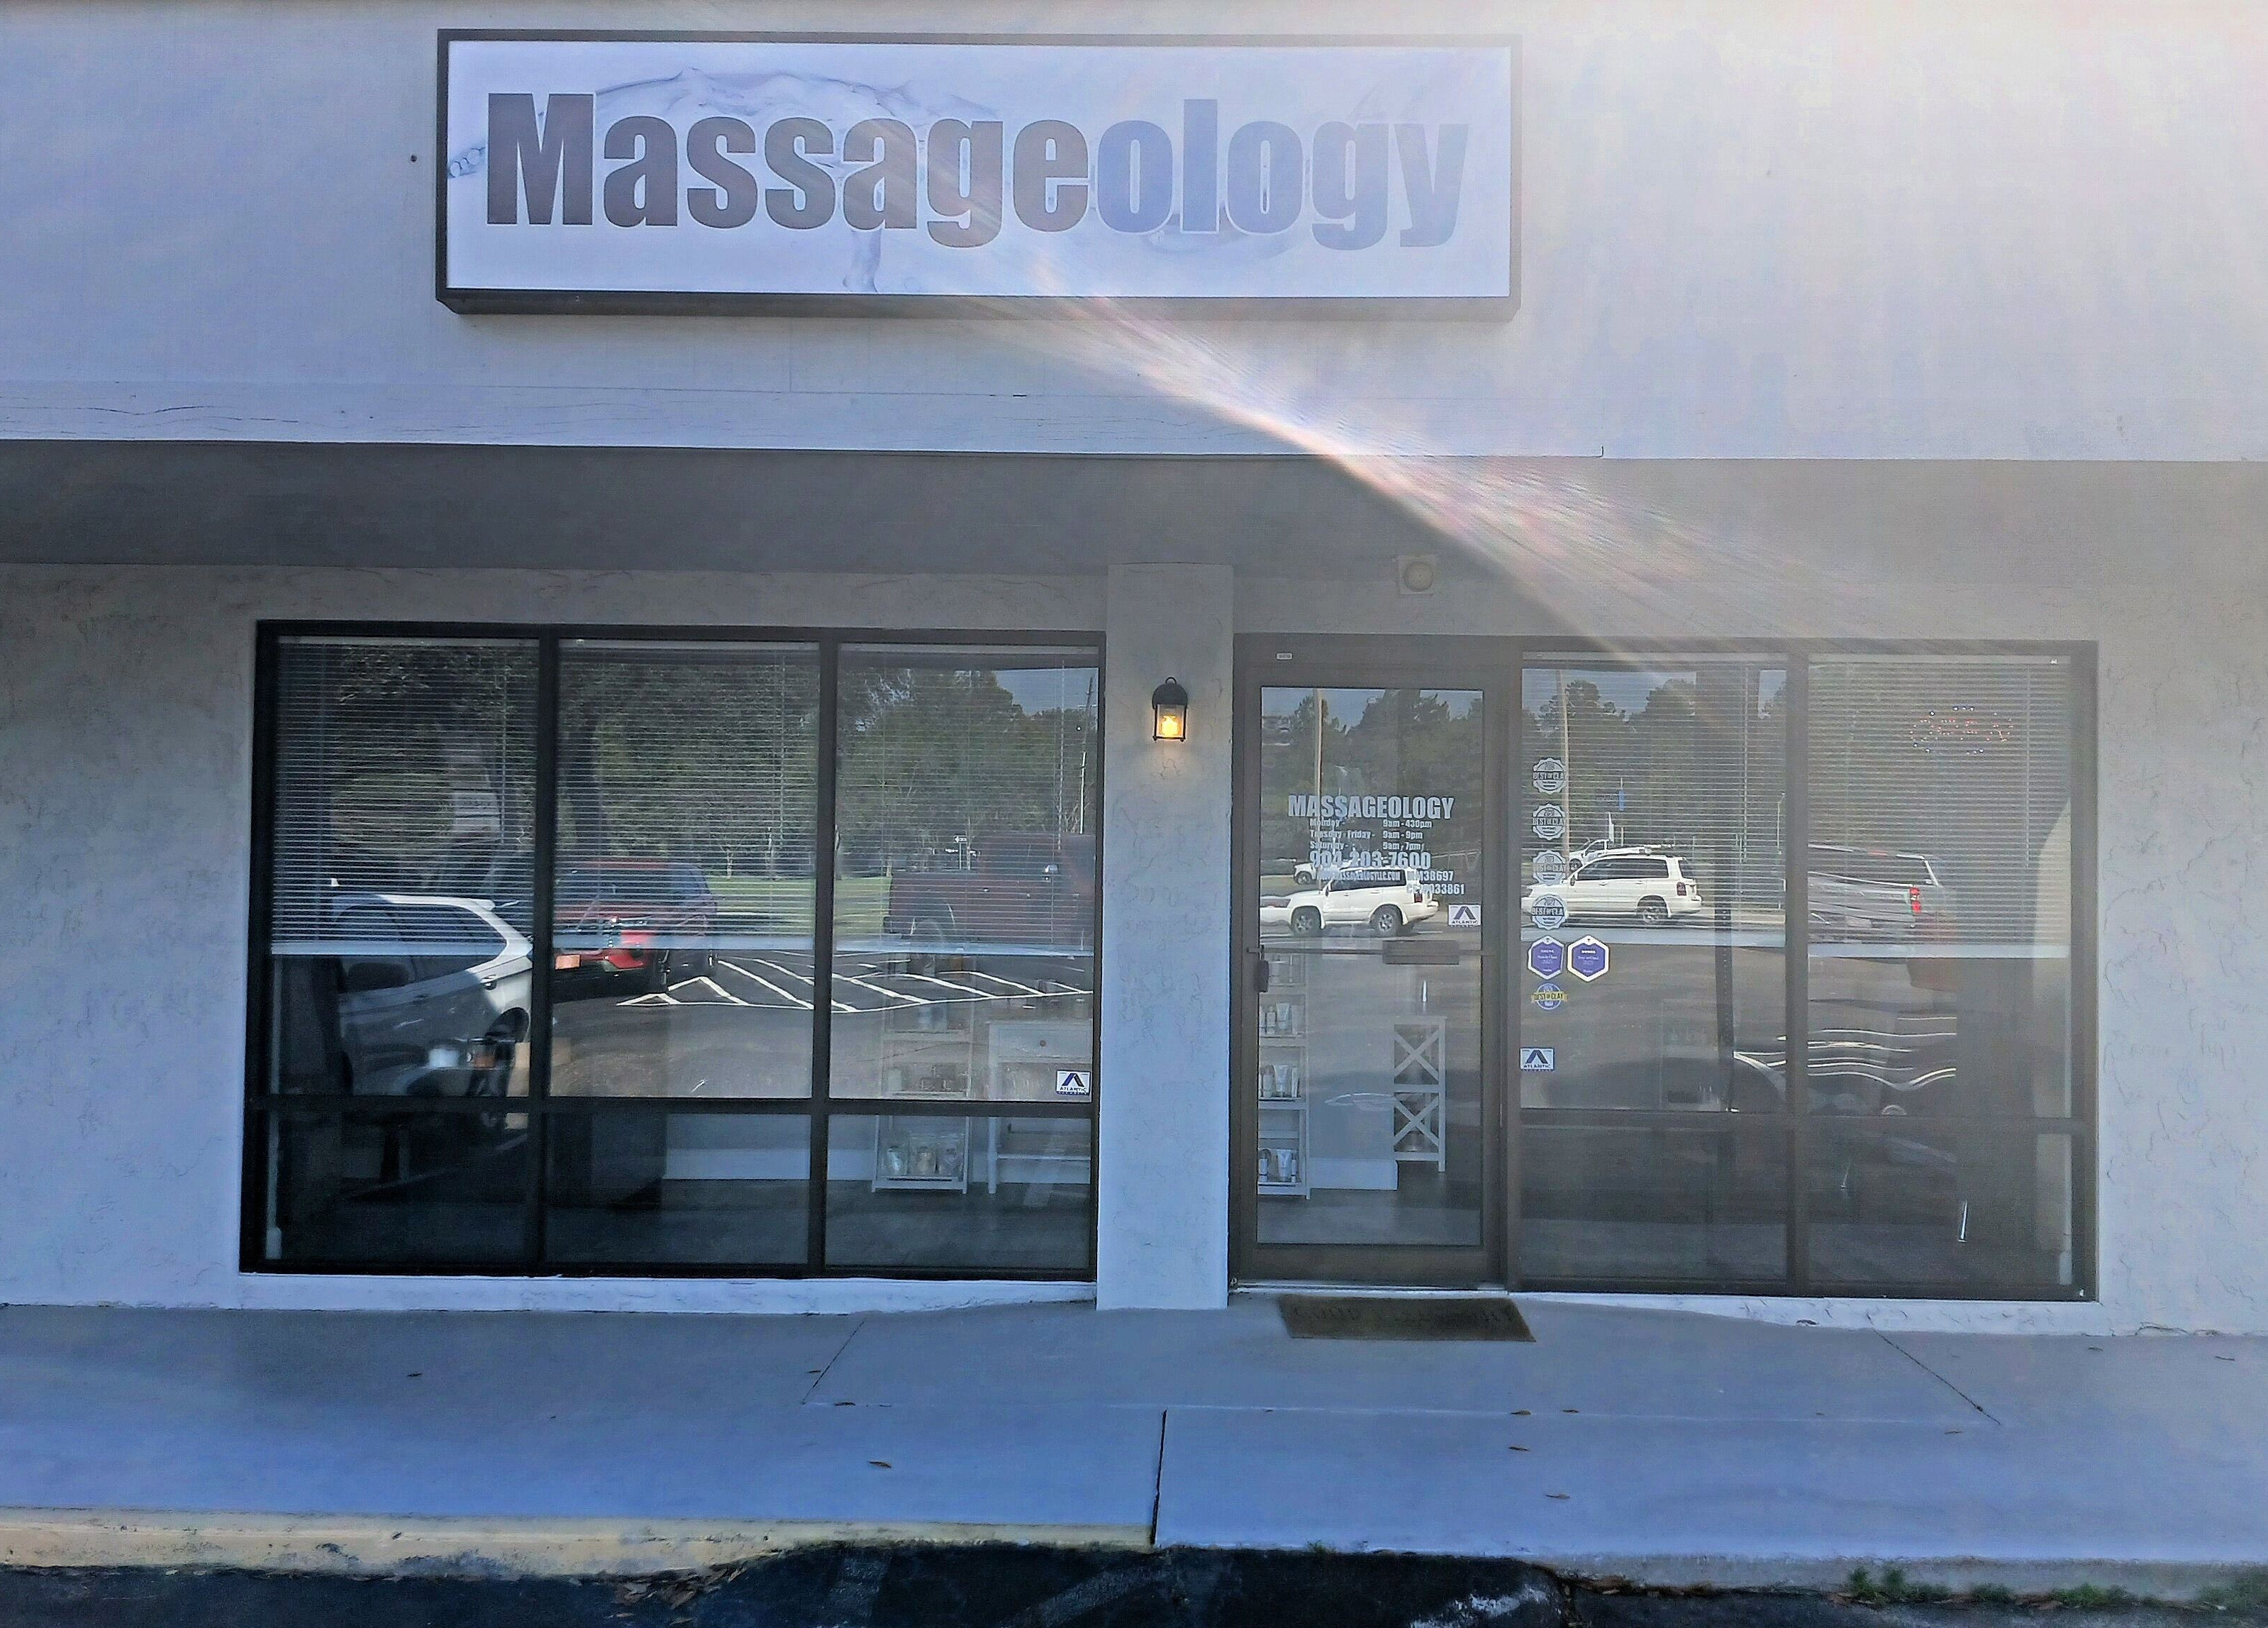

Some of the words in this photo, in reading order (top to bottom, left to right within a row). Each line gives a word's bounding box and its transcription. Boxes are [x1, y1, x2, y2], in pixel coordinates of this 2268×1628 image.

[486, 92, 1469, 250] Massageology
[1289, 795, 1454, 819] MASSAGEOLOGY
[1310, 819, 1340, 827] Monday
[1310, 829, 1342, 838] Tuesday
[1406, 831, 1423, 839] 9pm
[1310, 841, 1344, 850] Saturday
[1405, 842, 1421, 851] 7pm
[1310, 851, 1431, 870] 904-203-7600
